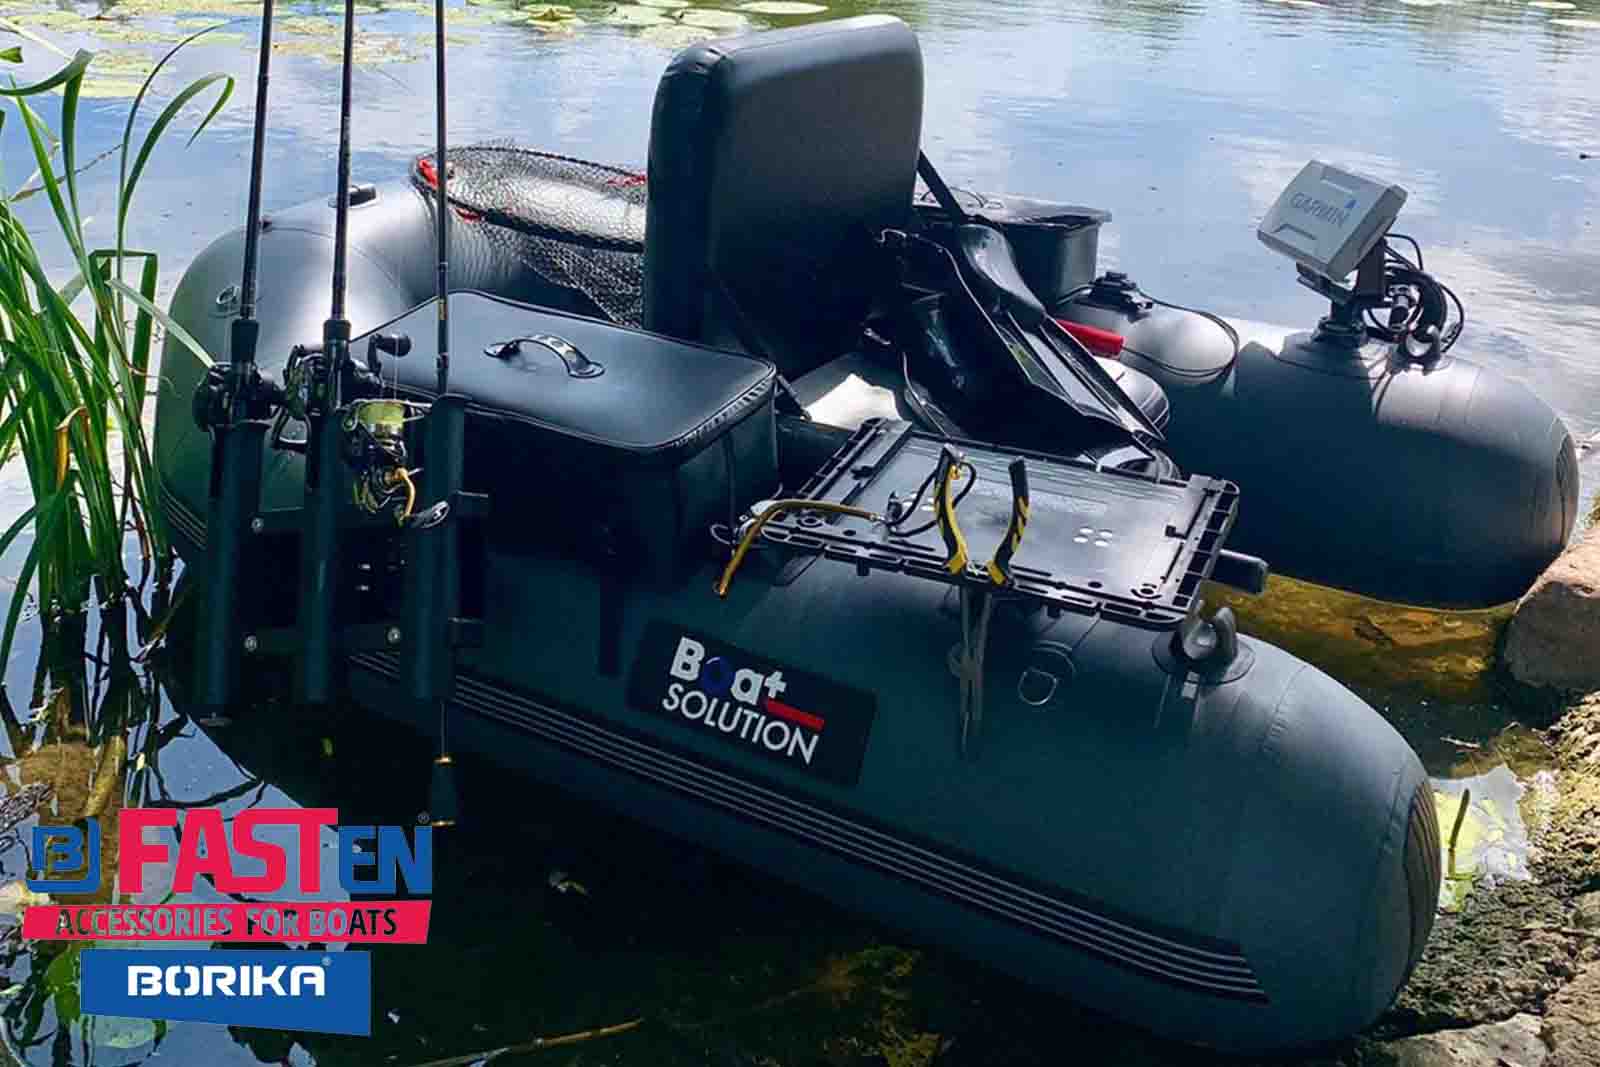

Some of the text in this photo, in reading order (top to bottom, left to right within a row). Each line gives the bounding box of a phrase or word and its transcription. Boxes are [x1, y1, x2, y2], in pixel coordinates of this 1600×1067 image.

[1289, 192, 1350, 229] GARMIN
[669, 637, 787, 705] Boat
[662, 683, 819, 765] SOLUTION
